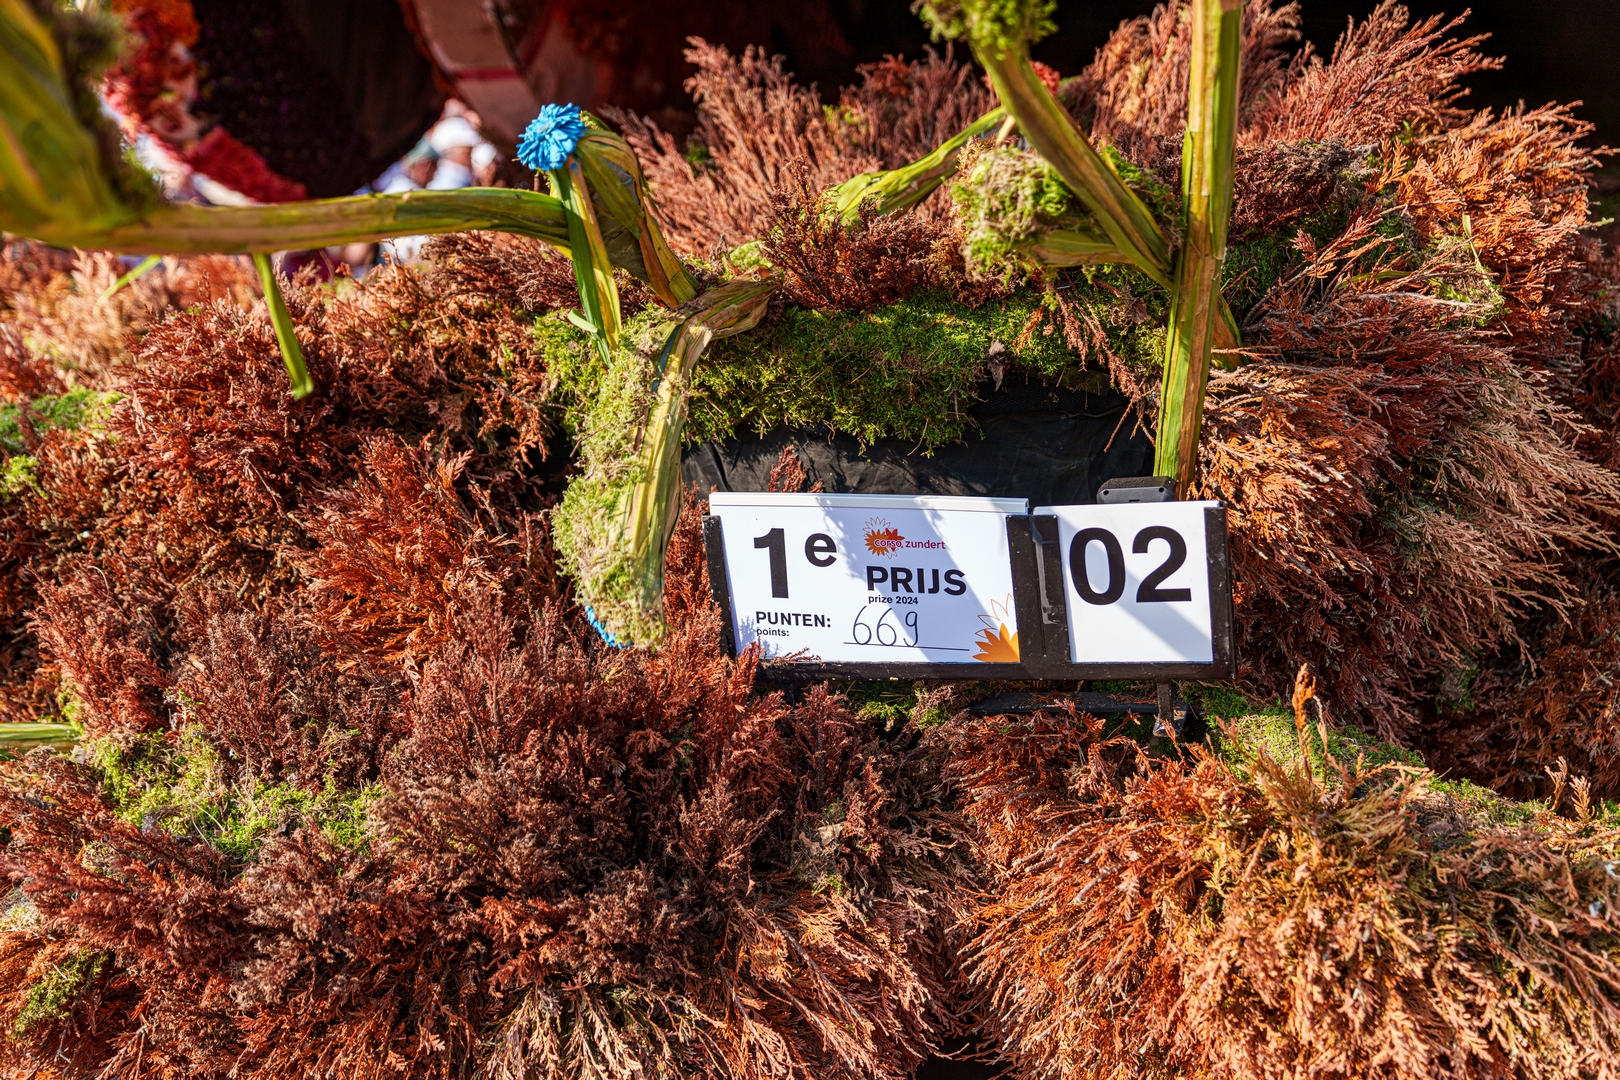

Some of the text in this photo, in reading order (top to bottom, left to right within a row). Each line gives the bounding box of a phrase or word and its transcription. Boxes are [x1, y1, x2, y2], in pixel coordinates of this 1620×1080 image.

[874, 539, 946, 550] corso zundert
[1069, 525, 1192, 605] 02
[866, 565, 967, 596] PRIJS
[868, 594, 919, 605] prize 2024
[755, 610, 832, 628] PUNTEN:
[852, 604, 920, 648] 669
[756, 626, 790, 637] points:
